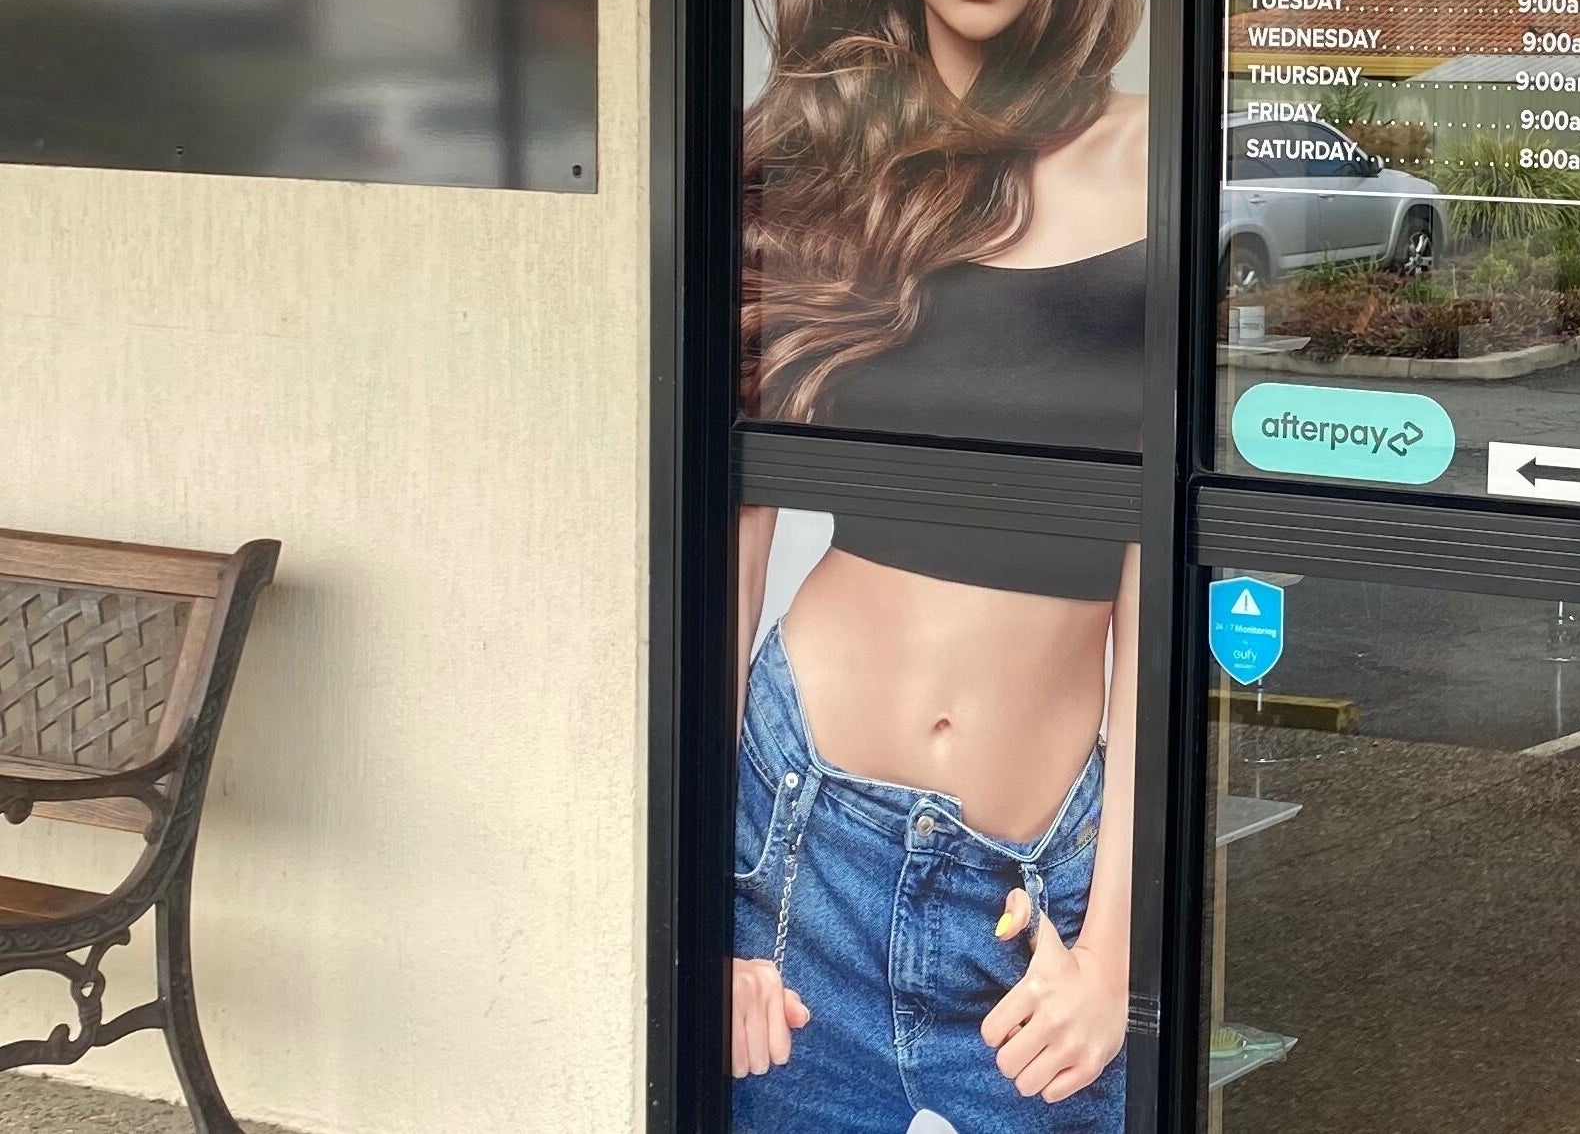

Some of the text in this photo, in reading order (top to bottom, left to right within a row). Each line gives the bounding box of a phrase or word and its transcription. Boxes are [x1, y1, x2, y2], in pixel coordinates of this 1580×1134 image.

[1248, 28, 1381, 49] WEDNESDAY
[1248, 65, 1362, 86] THURSDAY
[1247, 102, 1322, 122] FRIDAY
[1246, 139, 1359, 161] SATURDAY
[1260, 413, 1387, 456] afterpay
